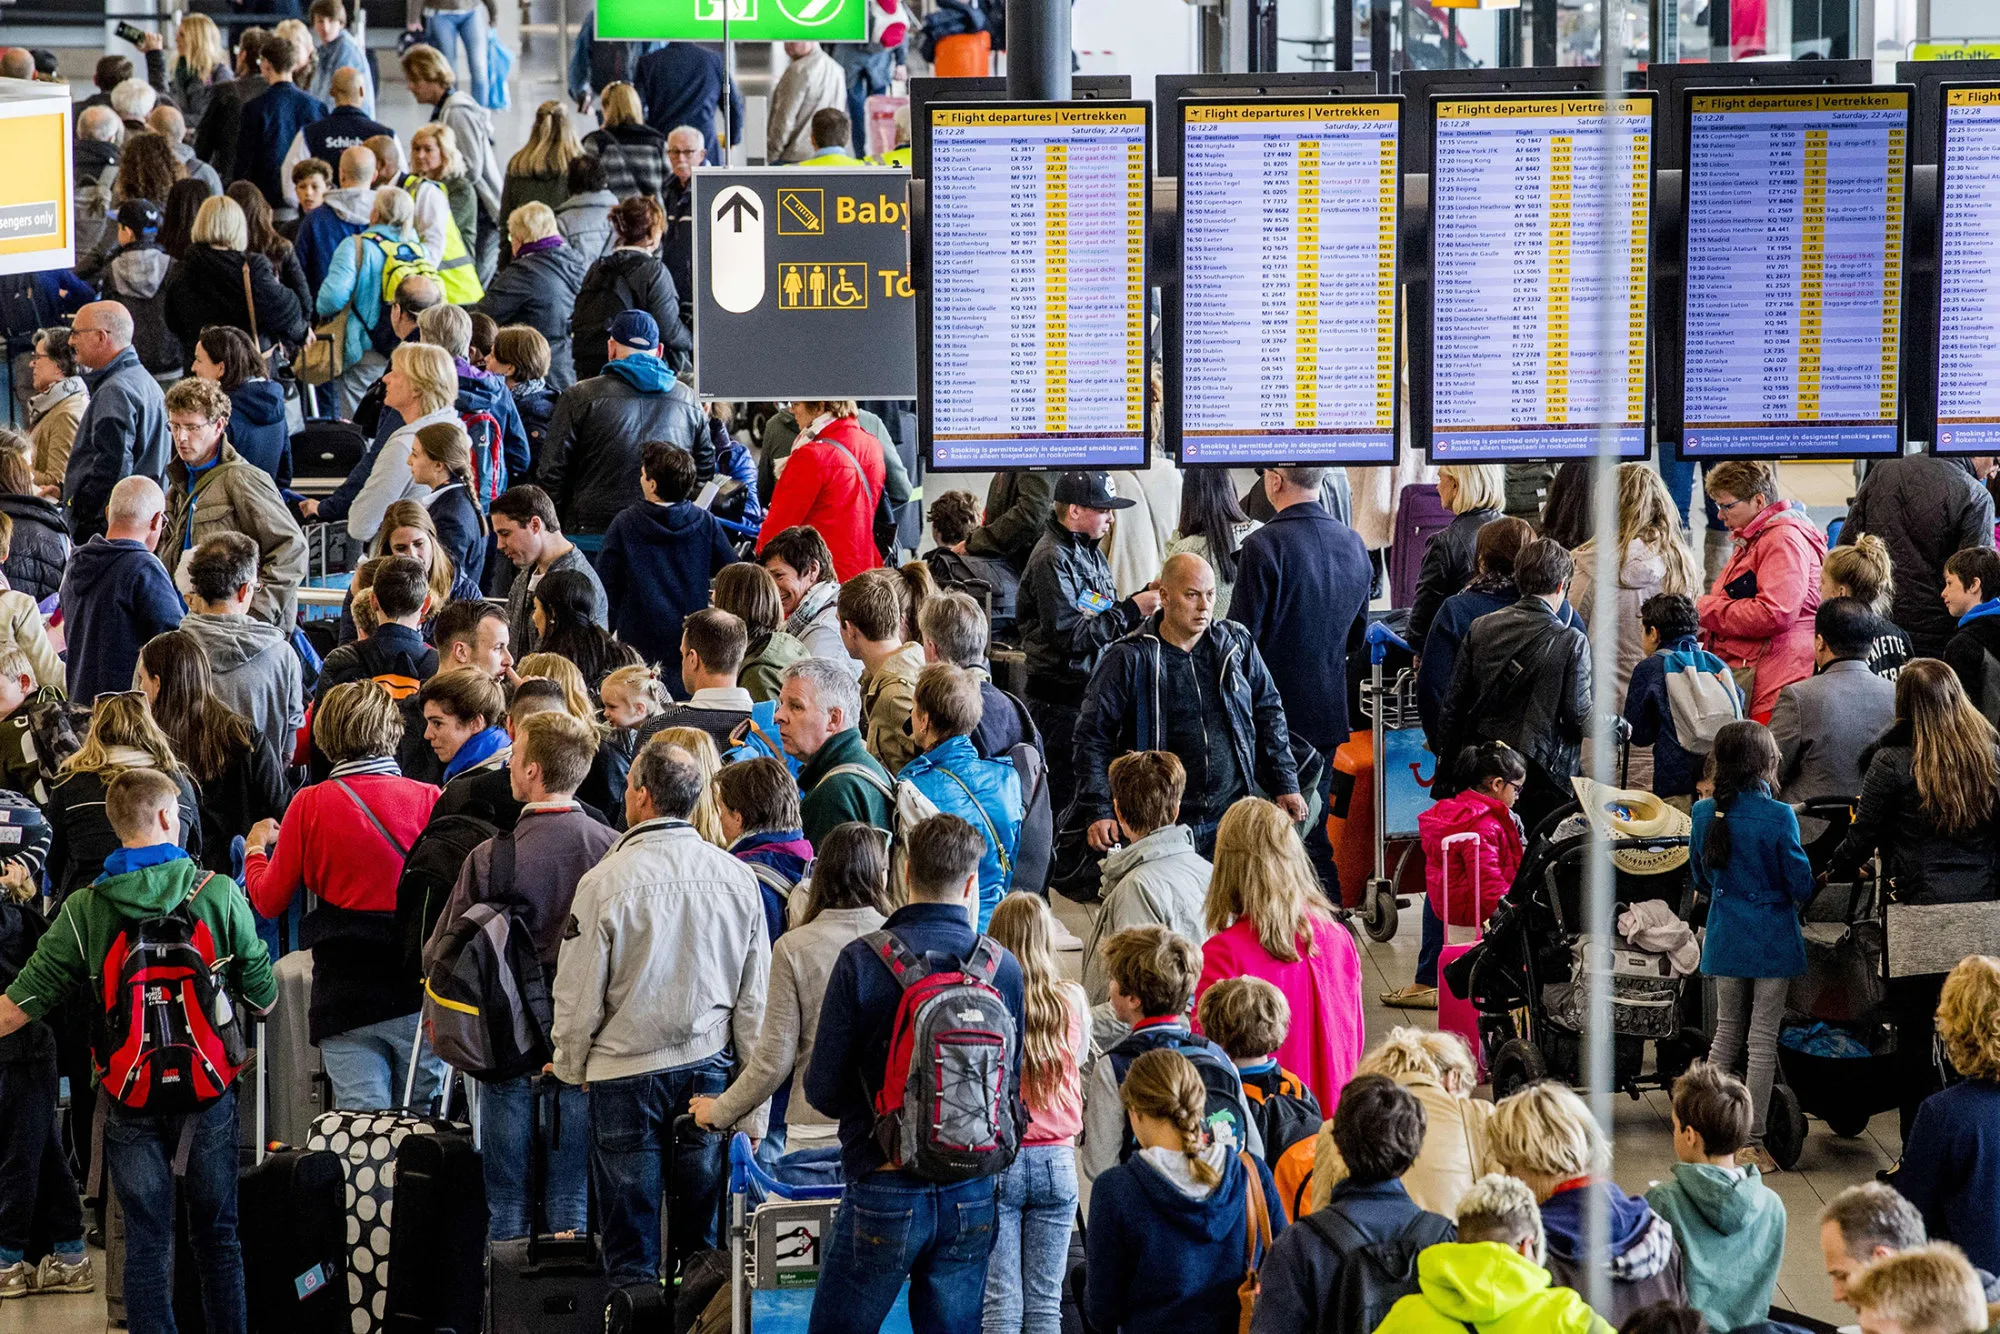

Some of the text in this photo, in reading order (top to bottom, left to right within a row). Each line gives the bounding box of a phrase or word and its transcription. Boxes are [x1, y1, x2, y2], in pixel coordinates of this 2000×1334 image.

[1712, 96, 1888, 110] Flight departures Vertrekken
[1205, 107, 1379, 120] Flight departures Vertrekken
[1458, 104, 1490, 116] Flight
[1494, 105, 1557, 115] departures
[952, 111, 1126, 124] Flight departures Vertrekken
[1626, 117, 1646, 125] April
[34, 210, 54, 228] only
